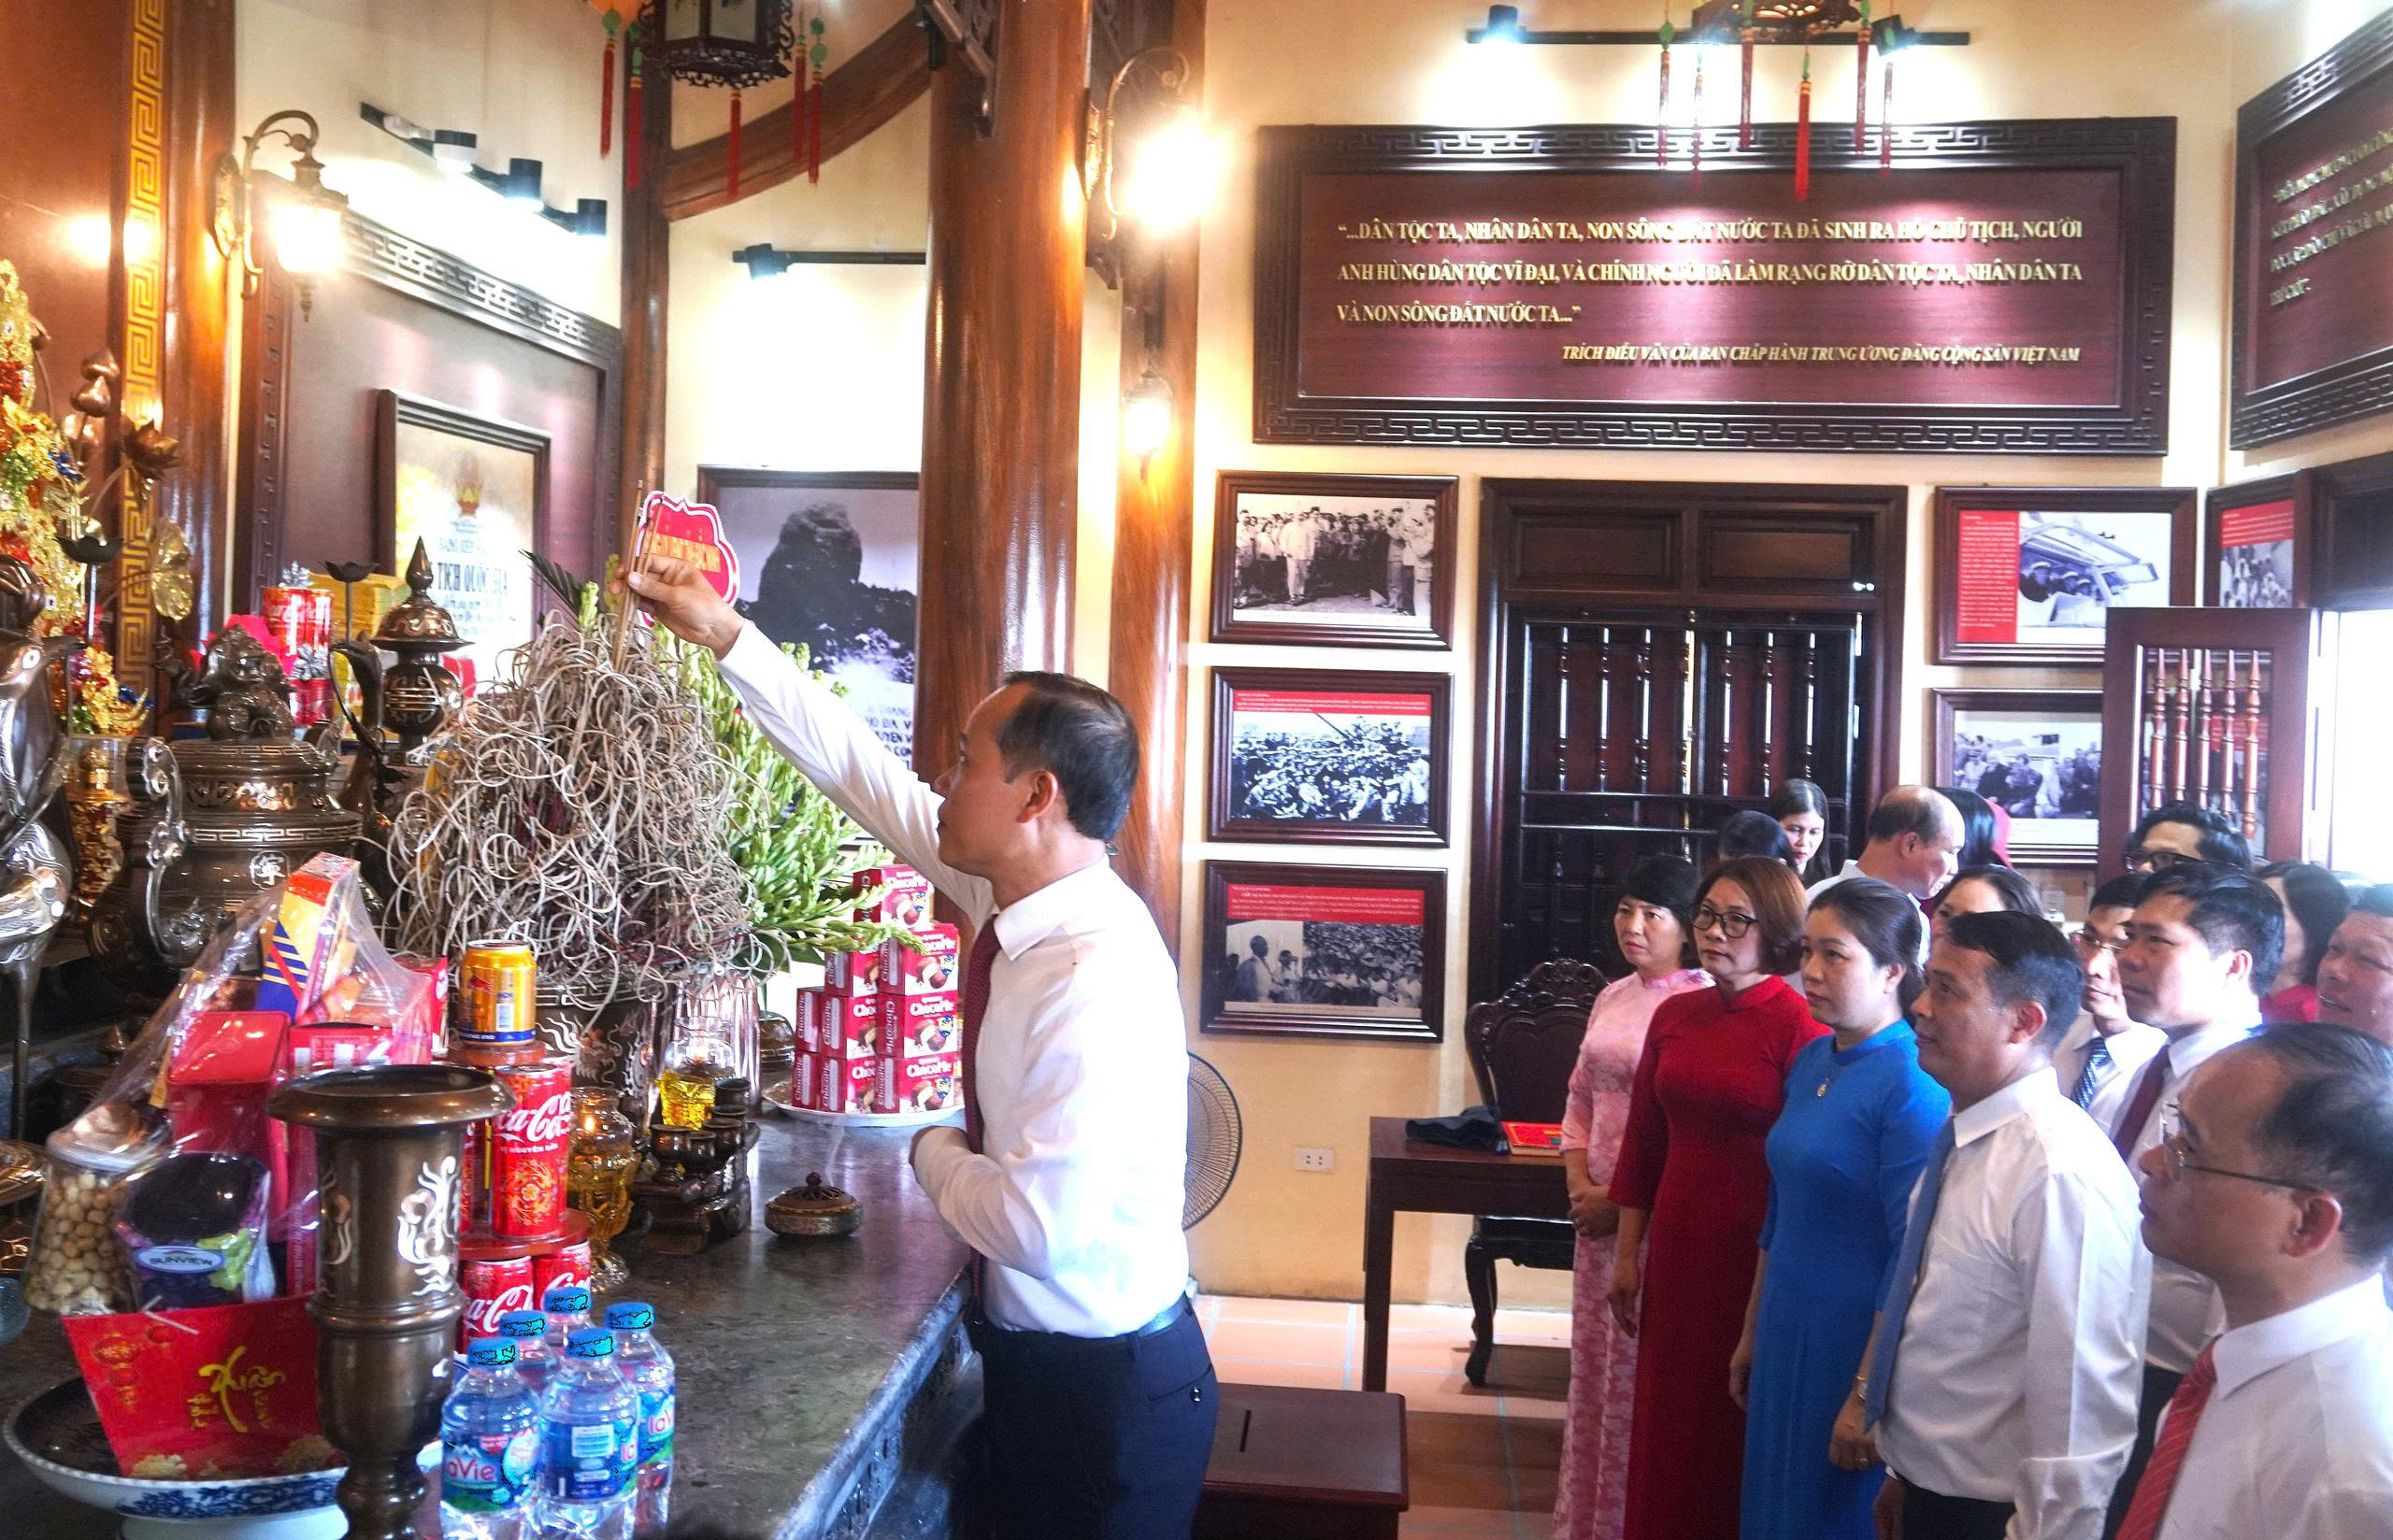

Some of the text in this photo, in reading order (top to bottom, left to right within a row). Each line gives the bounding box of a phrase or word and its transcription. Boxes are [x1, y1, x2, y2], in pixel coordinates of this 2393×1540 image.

[1397, 221, 1434, 243] TỘC
[1437, 222, 1463, 241] TA,
[1465, 217, 1514, 239] NHÂN
[1518, 217, 1554, 239] DÂN
[1556, 221, 1583, 241] TA,
[1586, 222, 1625, 239] NON
[1626, 217, 1676, 239] SÔNG
[1716, 217, 1768, 239] NƯỚC
[1771, 221, 1795, 239] TA
[1797, 218, 1821, 239] ĐÃ
[1825, 221, 1867, 239] SINH
[1870, 221, 1897, 239] RA
[1970, 221, 2019, 243] TỊCH,
[2022, 216, 2083, 239] NGƯỜI
[1338, 264, 1373, 280] ANH
[1376, 259, 1426, 280] HÙNG
[1427, 259, 1465, 280] DÂN
[1466, 262, 1503, 284] TỘC
[1505, 260, 1524, 280] VĨ
[1525, 263, 1560, 284] ĐẠI,
[1562, 259, 1586, 280] VÀ
[1588, 259, 1646, 280] CHÍNH
[1707, 259, 1732, 280] ĐÃ
[1734, 259, 1774, 280] LÀM
[1778, 263, 1827, 284] RẠNG
[1858, 258, 1896, 280] DÂN
[1897, 262, 1936, 284] TỘC
[1966, 258, 2017, 280] NHÂN
[2019, 258, 2056, 280] DÂN
[2059, 264, 2083, 280] TA
[1337, 301, 1360, 321] VÀ
[1363, 306, 1399, 321] NON
[1401, 300, 1449, 321] SÔNG
[1449, 300, 1485, 321] ĐẤT
[1486, 300, 1536, 321] NƯỚC
[1563, 342, 1603, 360] TRÍCH
[1698, 346, 1728, 361] BAN
[1730, 343, 1768, 361] CHẤP
[1769, 343, 1809, 361] HÀNH
[1812, 347, 1857, 361] TRUNG
[2047, 347, 2081, 362] NAM
[444, 1455, 495, 1482] aVie
